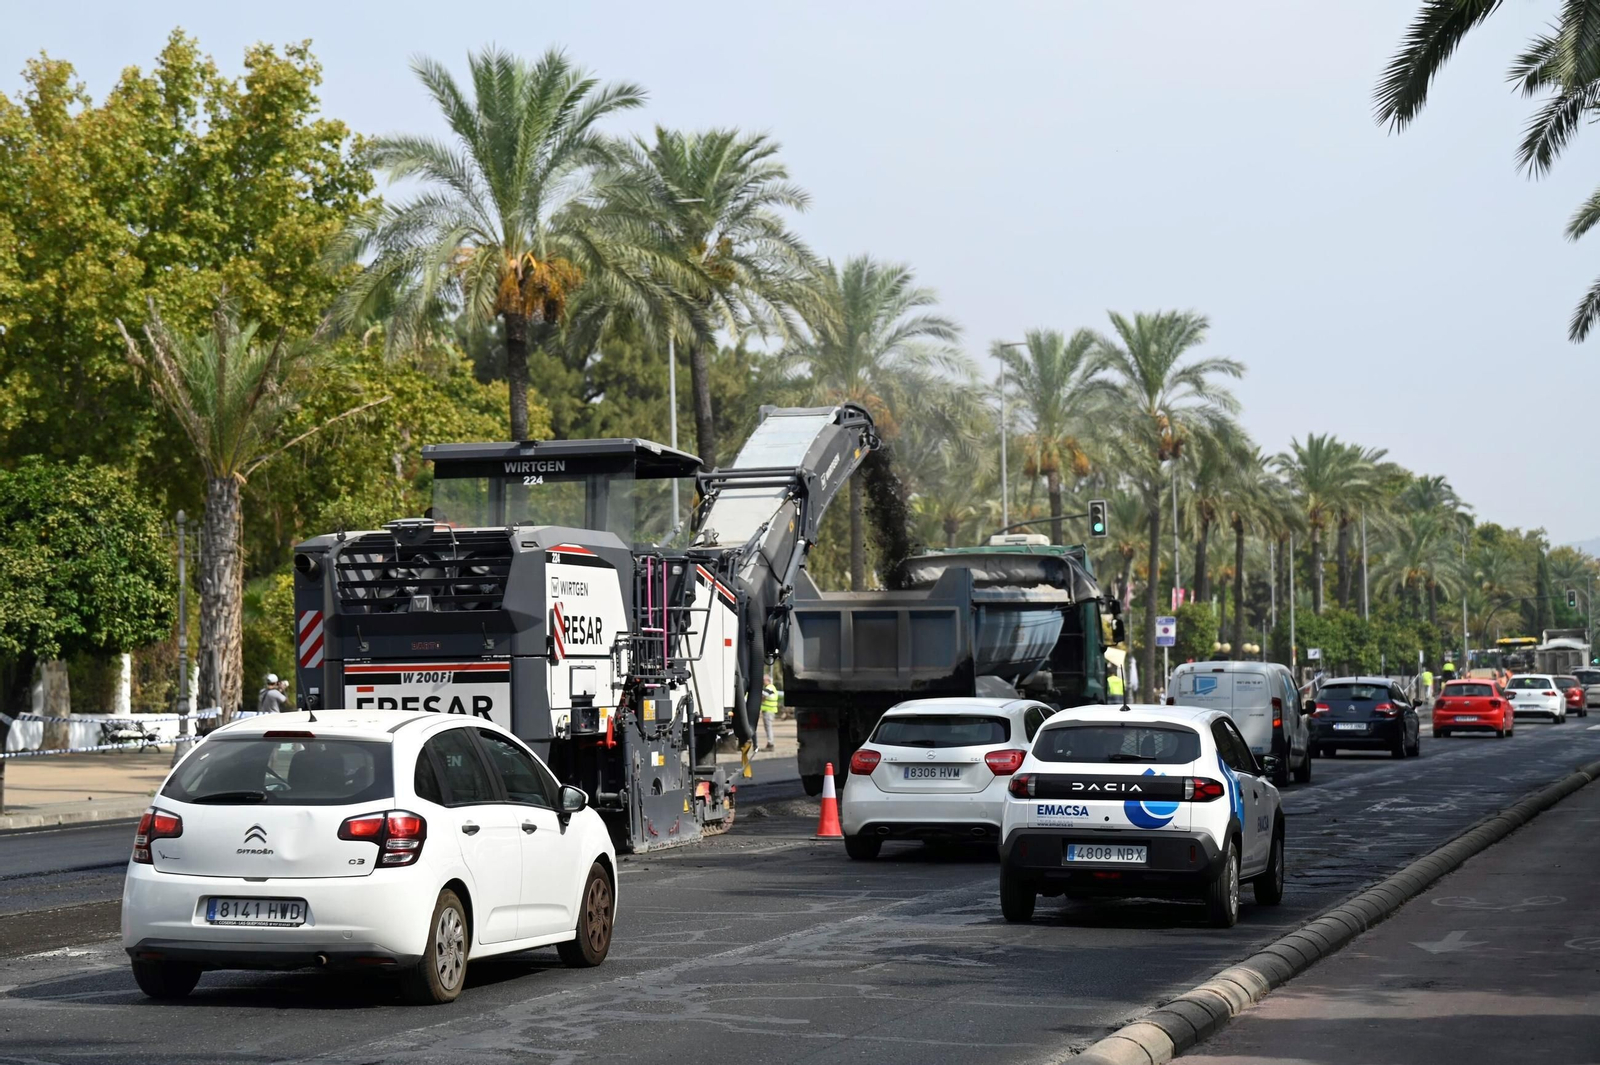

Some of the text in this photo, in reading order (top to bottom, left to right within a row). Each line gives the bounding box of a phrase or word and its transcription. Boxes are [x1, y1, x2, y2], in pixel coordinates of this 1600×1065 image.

[504, 461, 566, 473] WIRTGEN
[523, 475, 544, 486] 224
[560, 581, 588, 596] WIRTGEN
[563, 616, 602, 645] RESAR
[403, 673, 414, 683] W
[910, 767, 960, 778] 8306 HVM
[1072, 782, 1142, 792] DACIA
[1037, 804, 1089, 817] EMACSA
[1077, 847, 1143, 861] 4808 NBX
[220, 901, 300, 920] 8141 HWD
